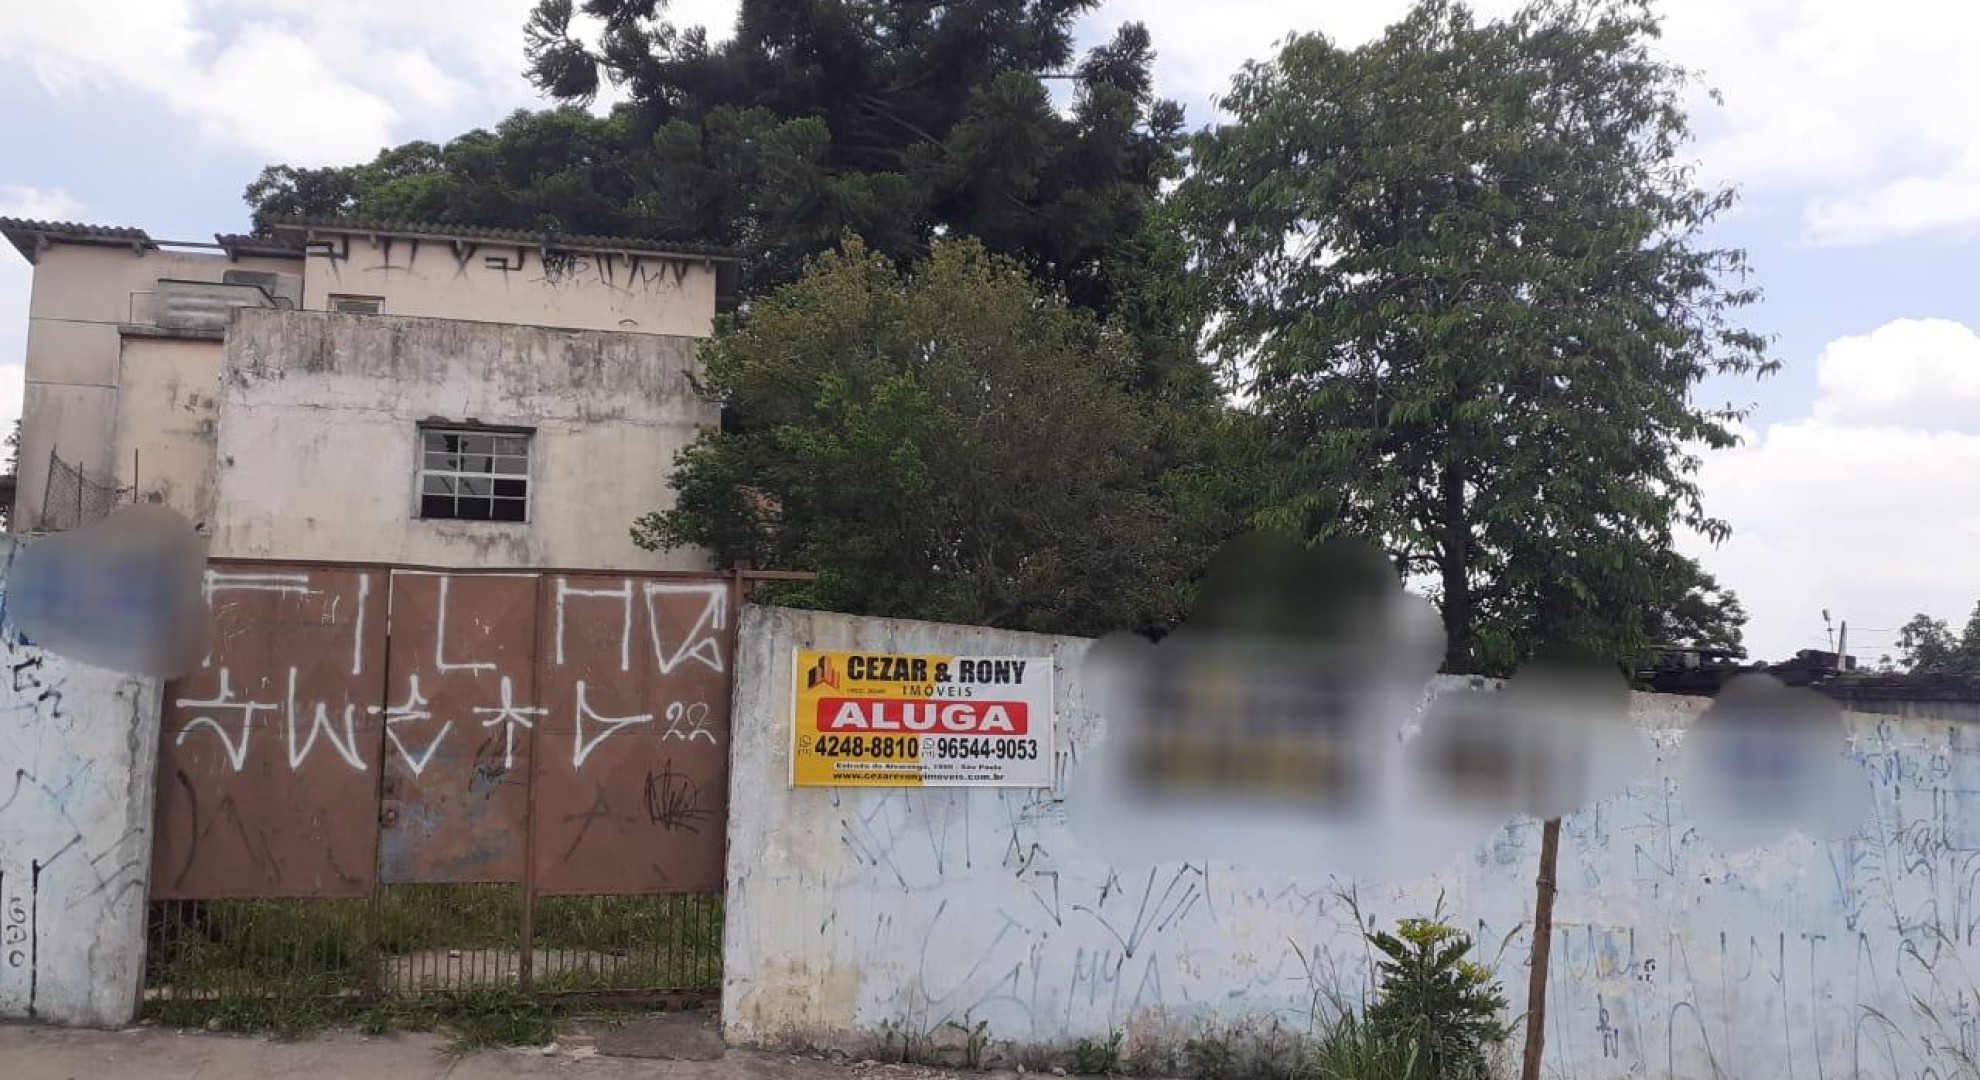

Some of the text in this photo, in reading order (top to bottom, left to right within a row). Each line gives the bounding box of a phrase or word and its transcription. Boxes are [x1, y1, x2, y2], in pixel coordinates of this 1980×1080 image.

[848, 655, 1026, 684] CEZAR & RONY
[903, 684, 973, 697] IMÓVEIS
[831, 702, 1014, 731] ALUGA
[815, 735, 919, 758] 4248-8810
[938, 737, 1037, 760] 96544-9053
